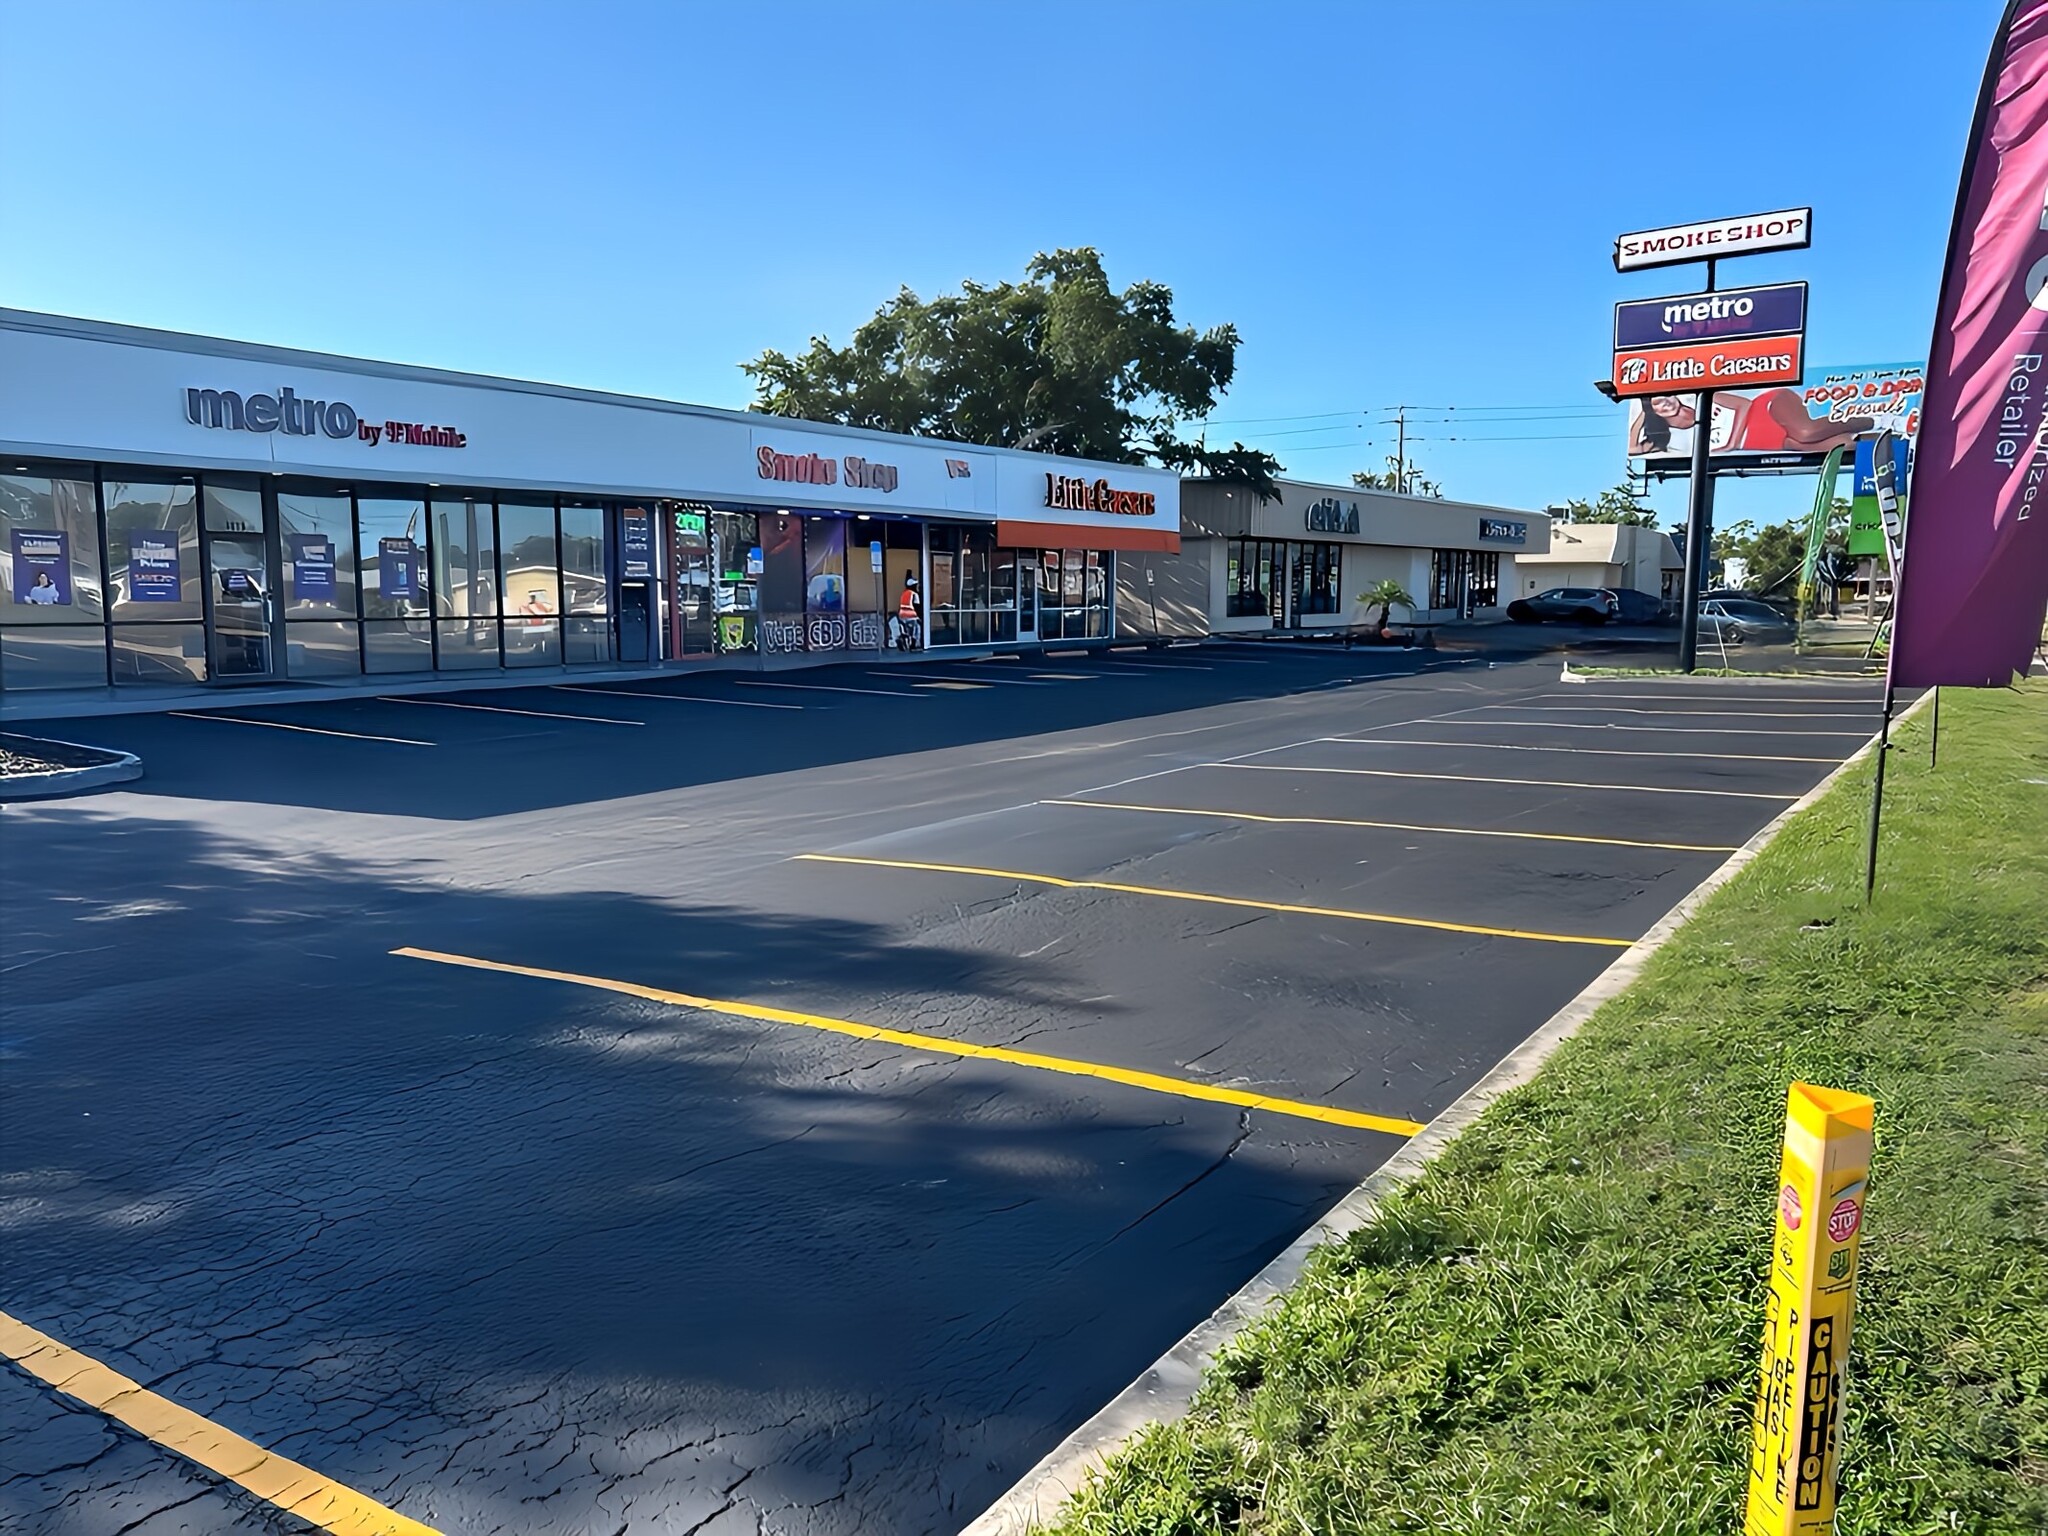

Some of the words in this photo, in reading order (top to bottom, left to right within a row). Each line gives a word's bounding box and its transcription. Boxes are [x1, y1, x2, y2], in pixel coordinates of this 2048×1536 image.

[1623, 229, 1722, 257] SMOKE
[1727, 218, 1804, 242] SHOP
[1663, 297, 1754, 325] metro
[1653, 358, 1705, 382] Little
[1710, 354, 1791, 378] Caesars
[1804, 384, 1859, 404] FOOD
[1993, 353, 2042, 470] Retailer
[183, 387, 357, 439] metro
[358, 418, 383, 447] by
[757, 446, 837, 486] Smoke
[1771, 1358, 1784, 1436] GAS
[1799, 1323, 1831, 1506] CAUTION
